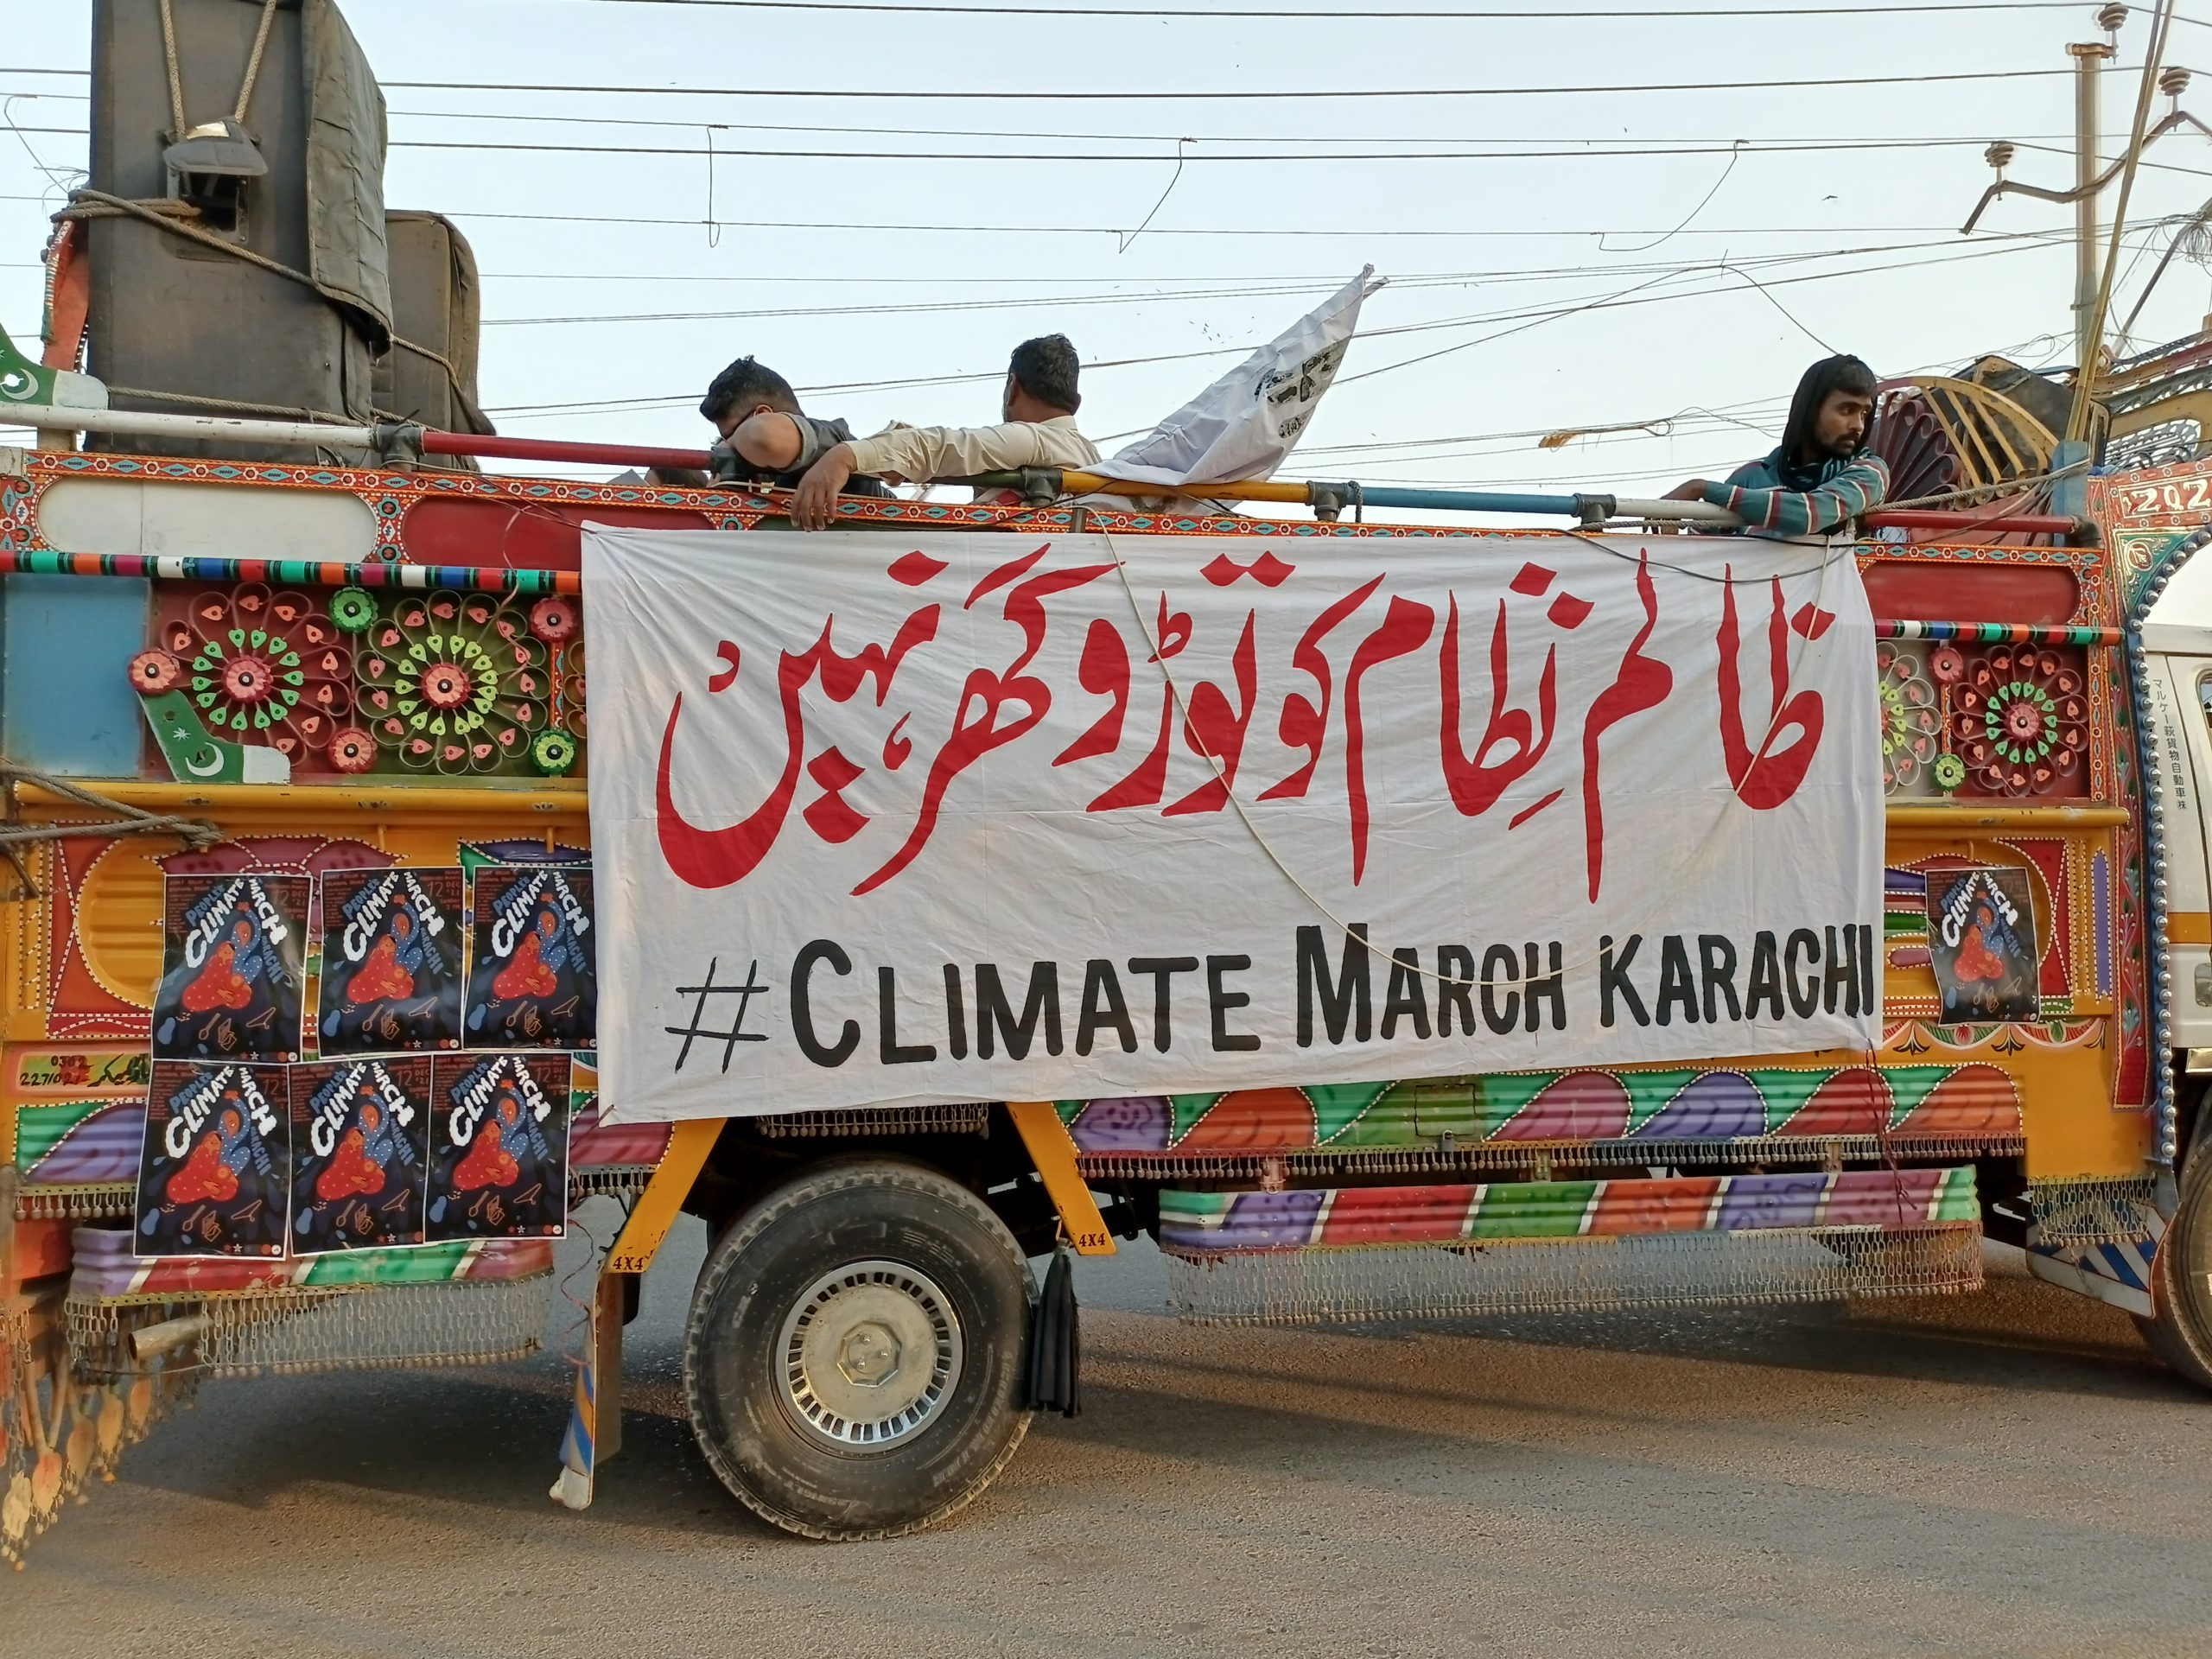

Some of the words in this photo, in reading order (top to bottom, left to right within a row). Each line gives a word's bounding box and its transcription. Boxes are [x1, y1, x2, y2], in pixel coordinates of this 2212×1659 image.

[849, 543, 1126, 896] گھر
[1256, 572, 1386, 801] کو
[249, 878, 289, 945] MARCH
[343, 871, 400, 962] CLIMATE
[404, 871, 445, 937] MARCH
[427, 880, 444, 898] 12
[492, 869, 549, 958] CLIMATE
[552, 870, 590, 937] MARCH
[1941, 871, 1980, 948] CLIMATE
[1982, 871, 2018, 927] MARCH
[185, 878, 245, 969] CLIMATE
[664, 939, 1262, 1074] #CLIMATE
[1296, 922, 1566, 1047] MARCH
[1599, 923, 1873, 1028] KARACHI
[238, 1066, 278, 1136] MARCH
[310, 1061, 367, 1157] CLIMATE
[371, 1061, 416, 1128] MARCH
[395, 1069, 413, 1087] 12
[414, 1068, 430, 1077] DEC
[448, 1055, 509, 1147] CLIMATE
[512, 1056, 551, 1122] MARCH
[534, 1066, 552, 1084] 12
[165, 1065, 235, 1159] CLIMATE
[613, 1255, 645, 1270] 4X4
[1078, 1232, 1106, 1248] 4X4
